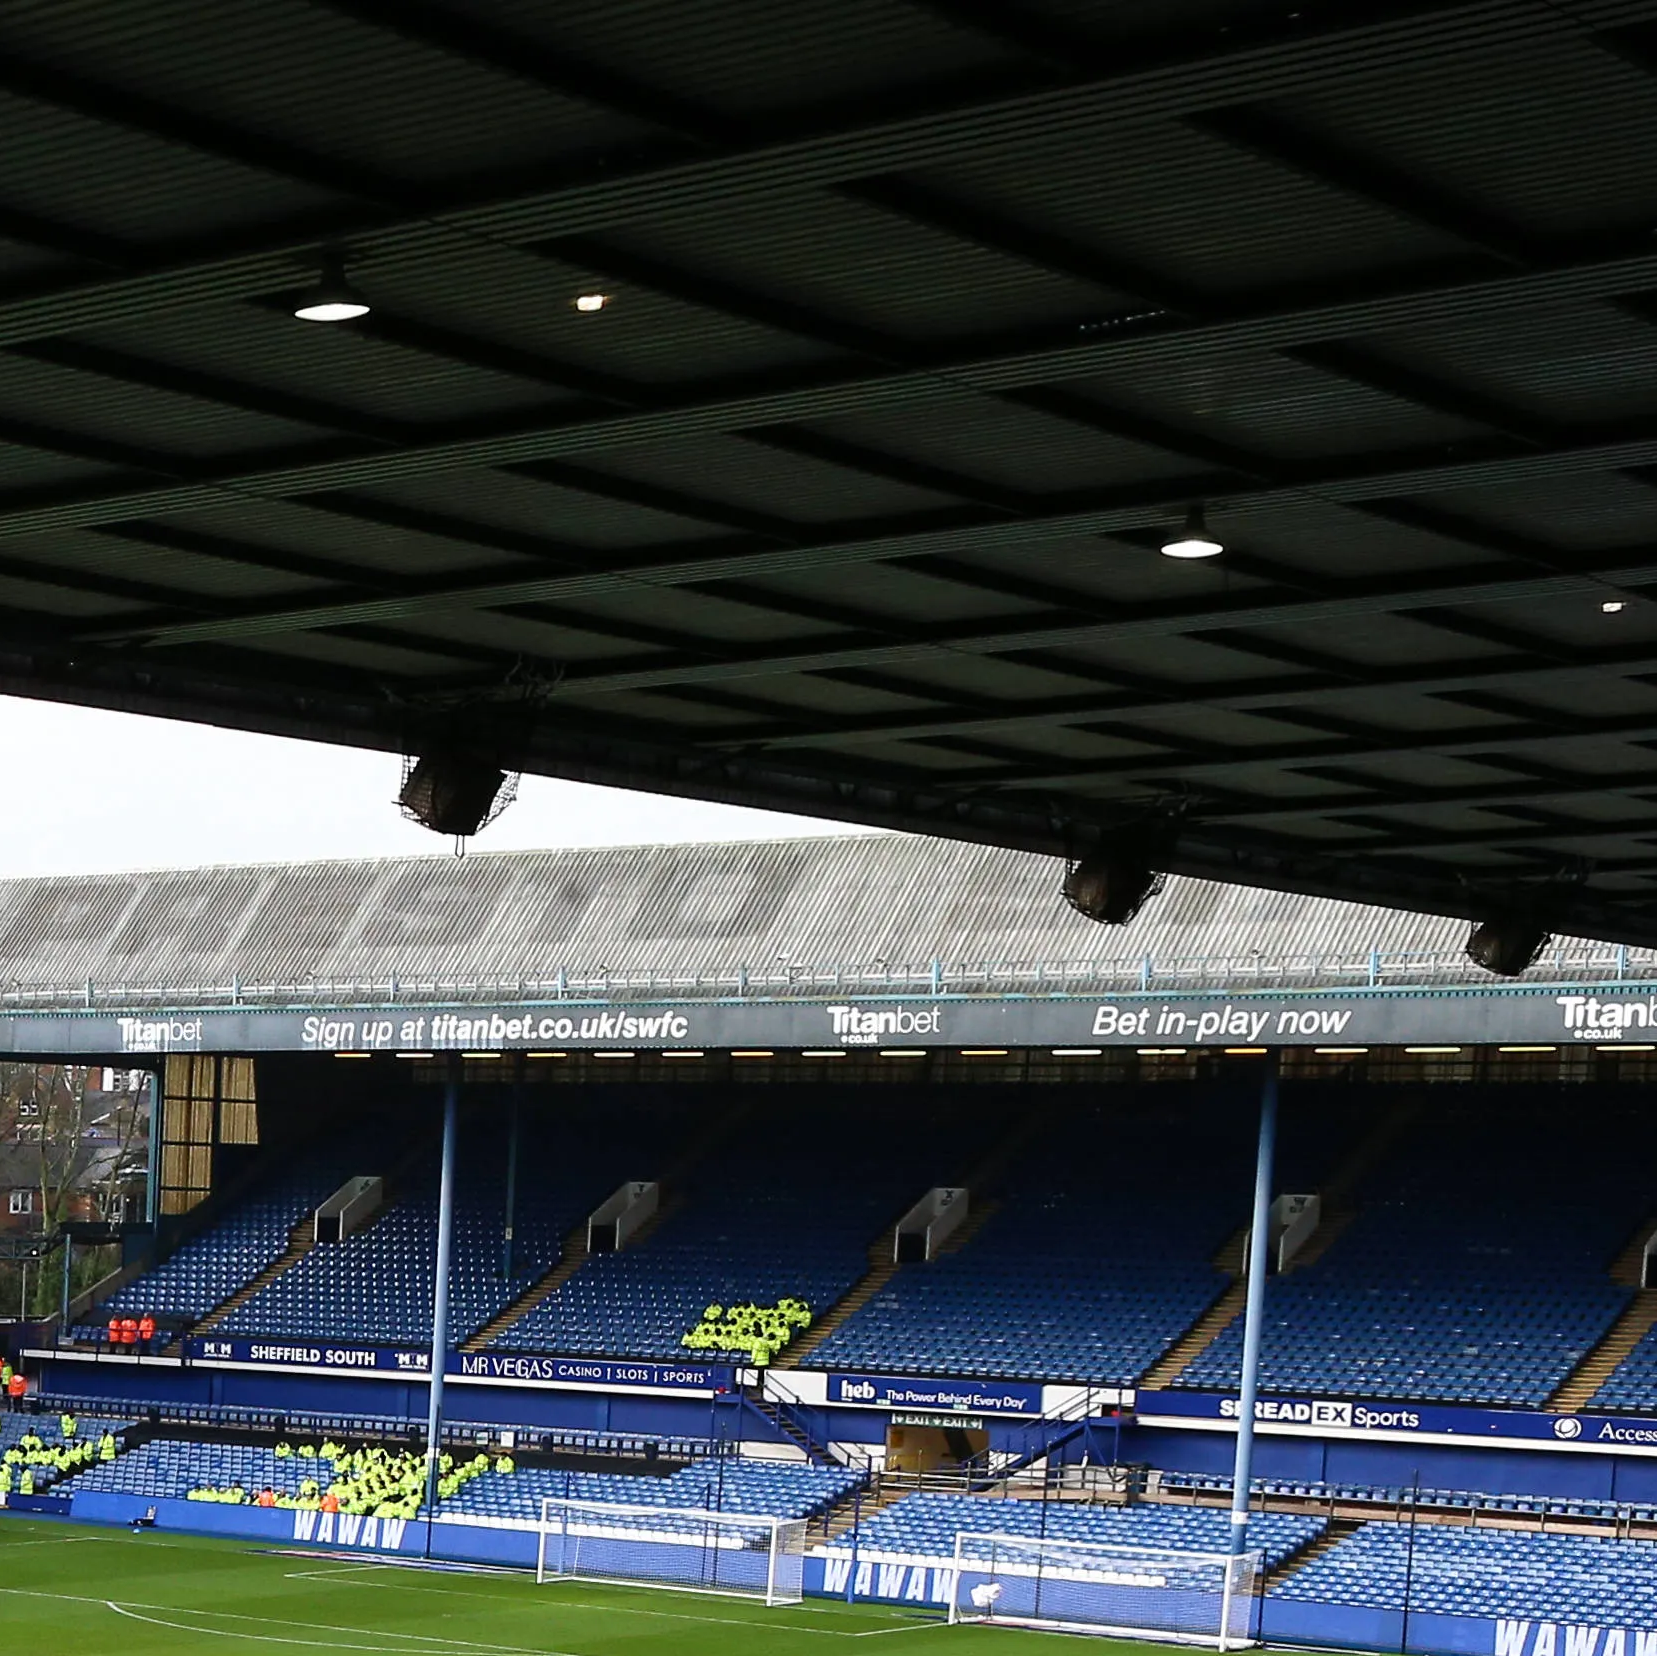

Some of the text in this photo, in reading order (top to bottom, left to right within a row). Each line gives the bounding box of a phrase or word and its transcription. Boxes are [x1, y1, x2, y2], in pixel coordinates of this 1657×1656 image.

[117, 1017, 202, 1041] Titanbet
[301, 1011, 689, 1047] Sign up at titanbet.co.uk/swfc
[826, 1004, 942, 1034] Titanbet
[1092, 1003, 1353, 1041] Bet in-play now
[250, 1345, 375, 1366] SHEFFIELD SOUTH
[462, 1356, 705, 1384] MR VEGAS CASINO SLOTS SPORTS
[841, 1380, 875, 1399] heb
[886, 1389, 904, 1401] The
[906, 1391, 936, 1403] Power
[938, 1393, 972, 1405] Behind
[973, 1395, 1002, 1409] Every
[905, 1413, 968, 1428] EXIT EXIT
[1219, 1399, 1419, 1429] SREADEX Sports
[293, 1509, 406, 1550] WAWAW
[823, 1559, 957, 1604] WAWAW
